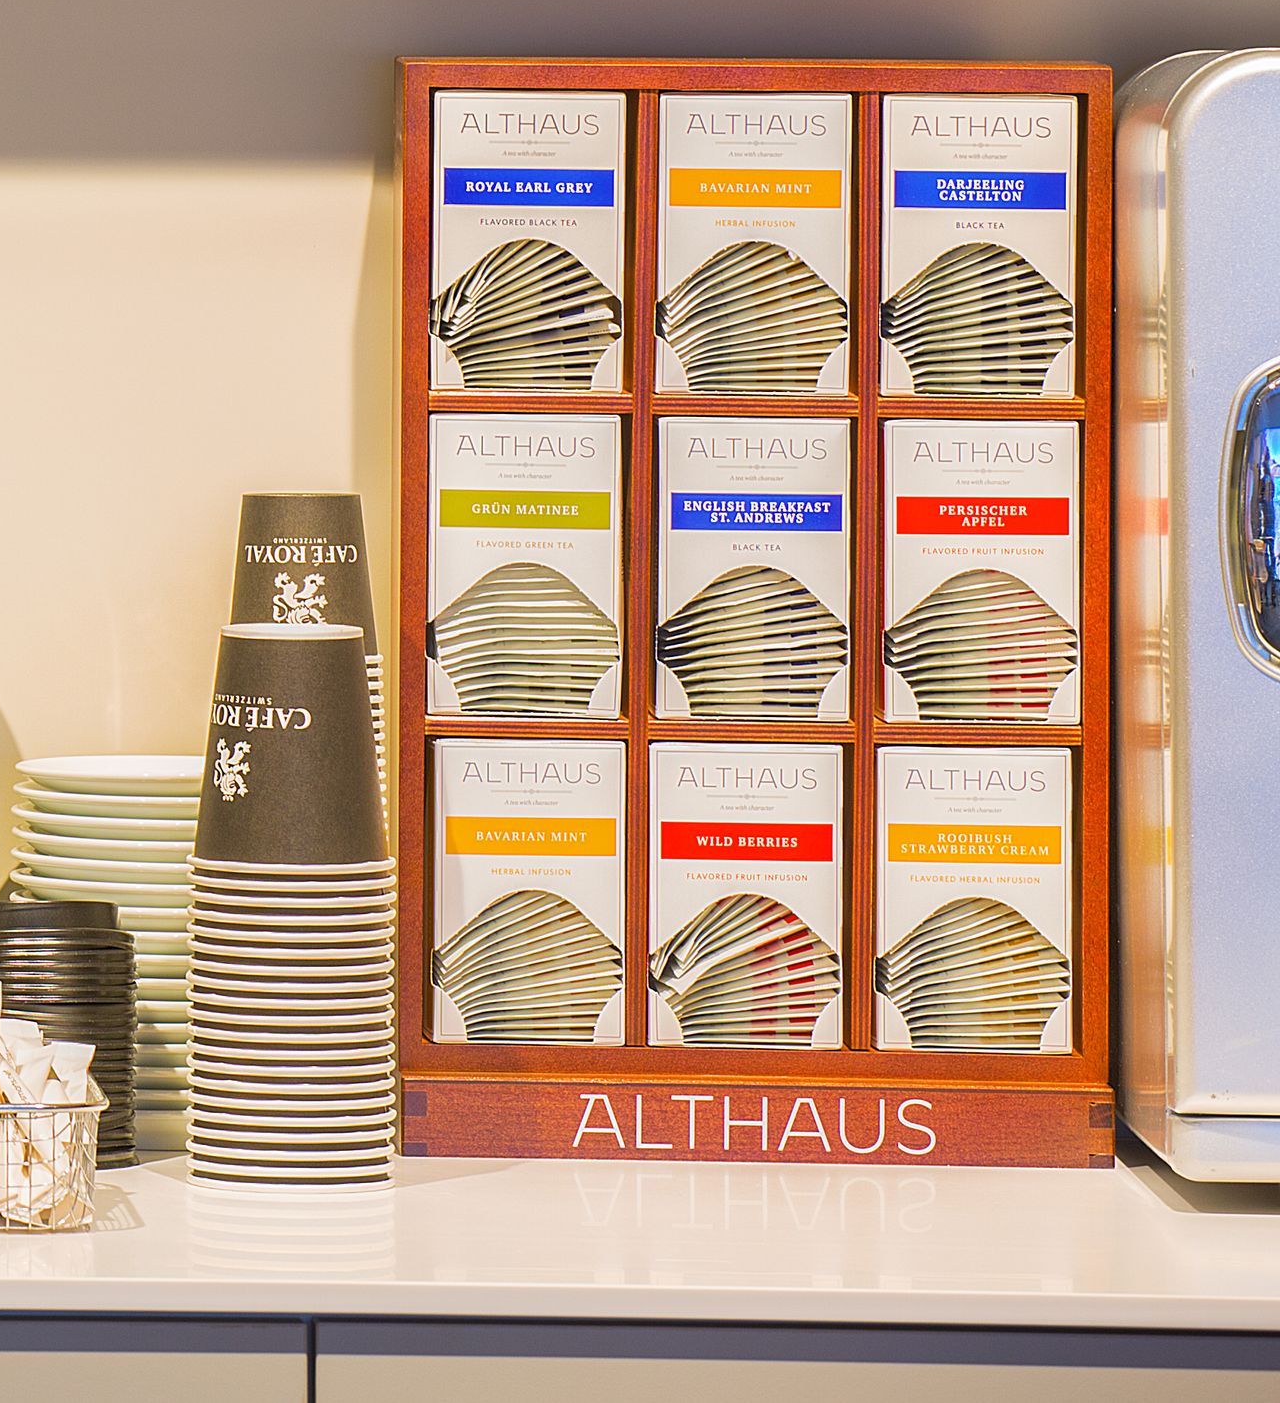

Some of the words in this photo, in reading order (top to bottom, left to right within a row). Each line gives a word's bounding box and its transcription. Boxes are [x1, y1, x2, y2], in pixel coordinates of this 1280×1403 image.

[460, 113, 600, 136] ALTHAUS
[687, 113, 827, 136] ALTHAUS
[911, 116, 1051, 138] ALTHAUS
[466, 182, 511, 192] ROYAL
[516, 182, 551, 193] EARL
[555, 183, 593, 193] GREY
[700, 183, 770, 193] BAVARIAN
[775, 184, 812, 194] MINT
[936, 179, 1024, 190] DARJEELING
[939, 190, 1022, 201] CASTELTON
[480, 218, 526, 226] FLAVORED
[457, 435, 595, 458] ALTHAUS
[688, 438, 827, 460] ALTHAUS
[913, 442, 1054, 464] ALTHAUS
[472, 502, 510, 514] GRÜN
[516, 505, 579, 516] MATINEE
[683, 501, 745, 512] ENGLISH
[751, 502, 831, 513] BREAKFAST
[939, 506, 1028, 516] PERSISCHER
[710, 513, 730, 523] ST.
[734, 513, 804, 523] ANDREWS
[962, 517, 1005, 527] APFEL
[477, 540, 521, 548] FLAVORED
[244, 545, 307, 564] ROYAL
[311, 545, 358, 567] CAFÉ
[212, 703, 241, 727] ROY
[245, 706, 312, 733] CAFÉ
[462, 762, 601, 784] ALTHAUS
[677, 766, 817, 790] ALTHAUS
[905, 769, 1046, 792] ALTHAUS
[476, 831, 545, 841] BAVARIAN
[551, 832, 588, 842] MINT
[697, 836, 732, 846] WILD
[738, 837, 798, 847] BERRIES
[938, 833, 1012, 844] ROOIBUSH
[901, 844, 995, 855] STRAWBERRY
[1000, 846, 1049, 855] CREAM
[910, 875, 956, 883] FLAVORED
[572, 1093, 937, 1156] ALTHAUS
